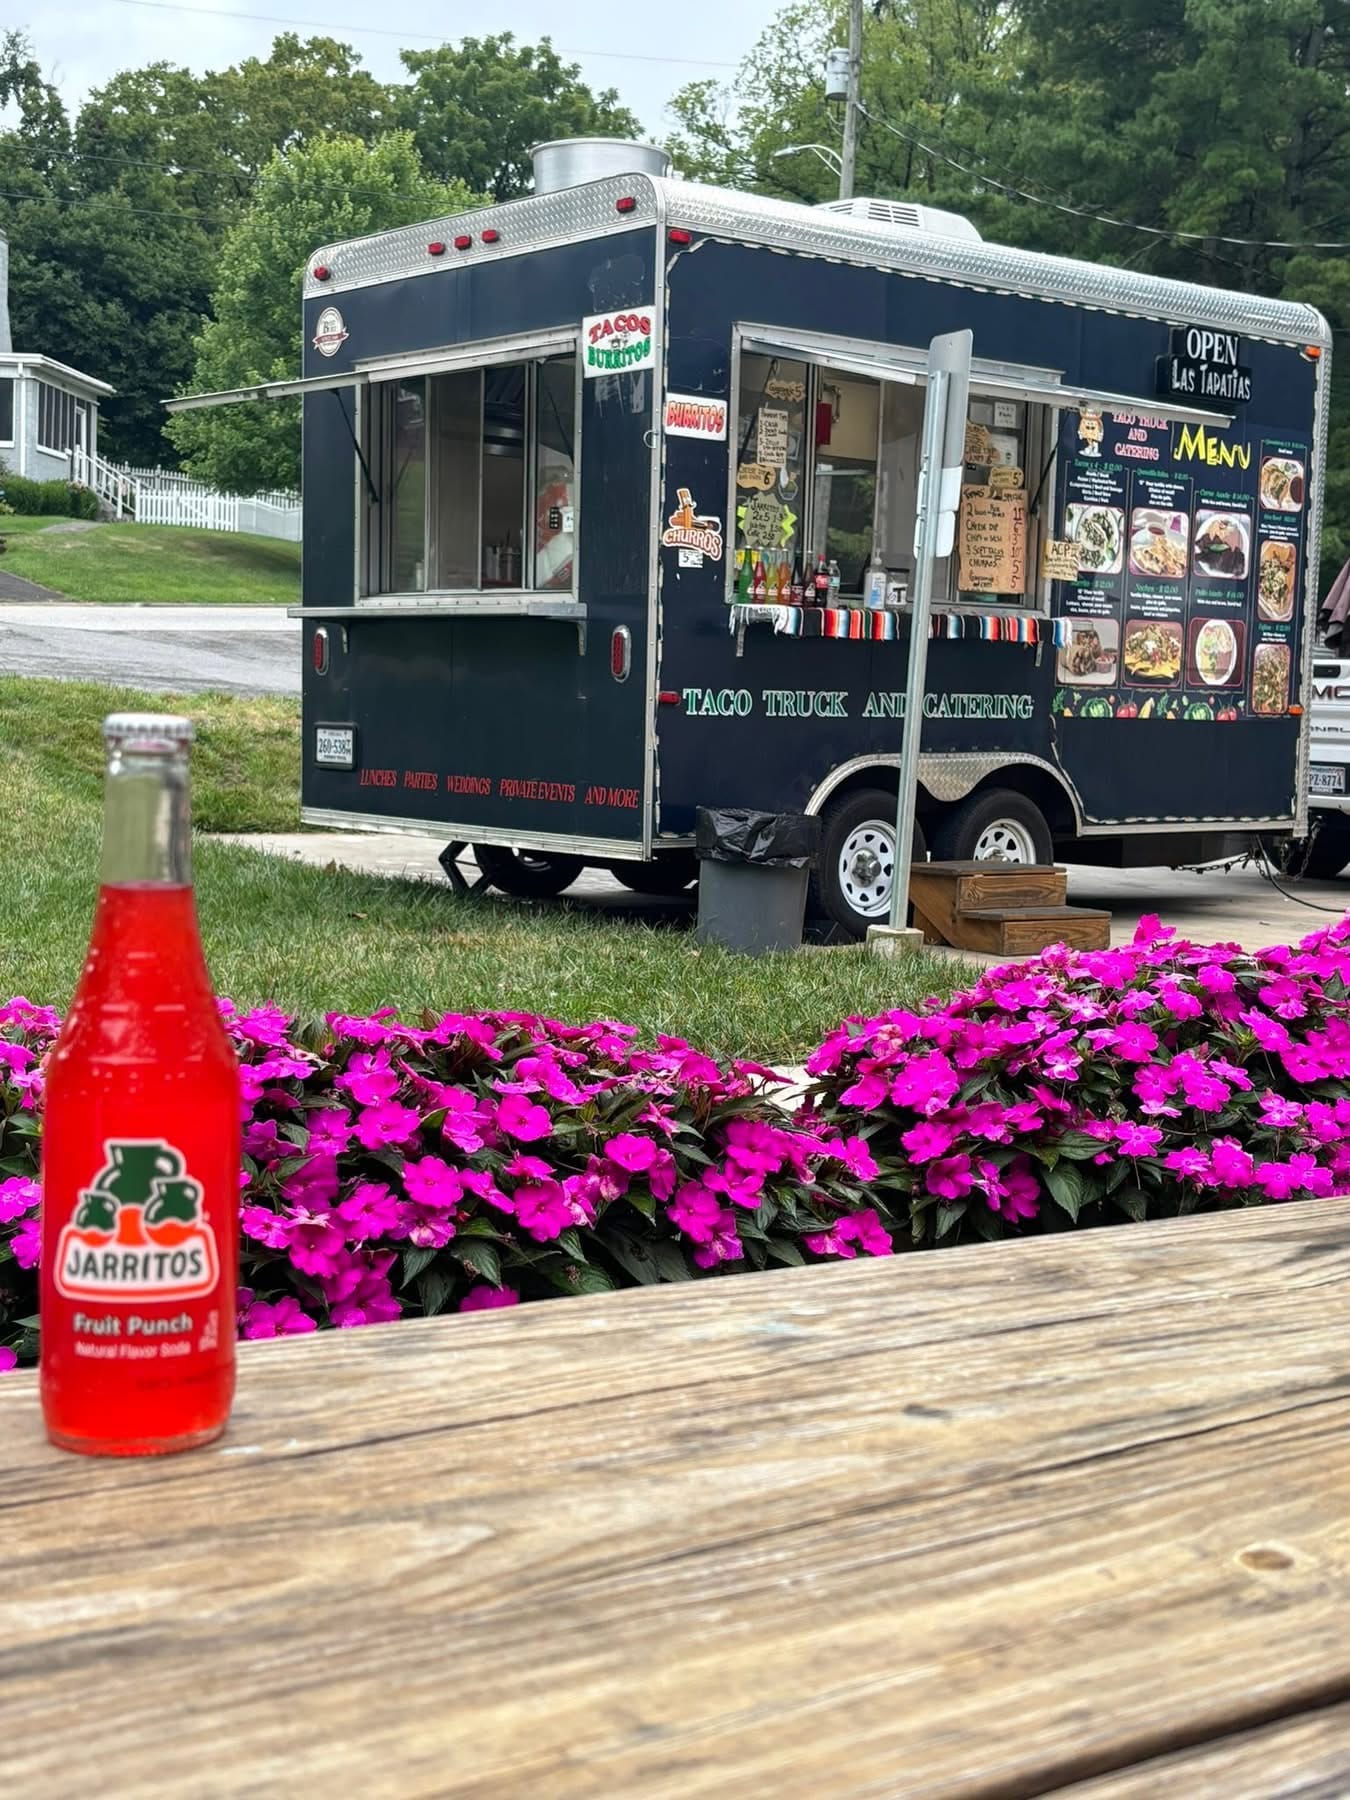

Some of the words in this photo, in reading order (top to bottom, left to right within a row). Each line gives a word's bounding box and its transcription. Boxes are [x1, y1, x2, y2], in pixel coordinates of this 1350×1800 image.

[589, 314, 651, 344] TACOS
[587, 336, 651, 369] BURRITOS
[1186, 328, 1238, 366] OPEN
[1172, 358, 1196, 392] LAS
[667, 400, 725, 433] BURRITOS
[1127, 428, 1147, 442] AND
[1173, 423, 1251, 470] MENU
[1114, 443, 1160, 461] CATERING
[664, 529, 722, 559] CHURROS
[682, 688, 753, 716] TACO
[762, 690, 849, 717] TRUCK
[922, 692, 1034, 719] CATERING
[1311, 684, 1350, 700] MC
[360, 769, 398, 787] LUNCHES
[403, 770, 438, 790] PARTIES
[499, 778, 538, 799] PRIVATE
[537, 782, 576, 802] EVENTS
[584, 786, 606, 805] AND
[606, 788, 640, 809] MORE
[66, 1247, 204, 1281] JARRITOS
[73, 1311, 121, 1336] Fruit
[127, 1311, 194, 1336] Punch
[74, 1341, 117, 1359] Natural
[119, 1342, 158, 1359] Flavor
